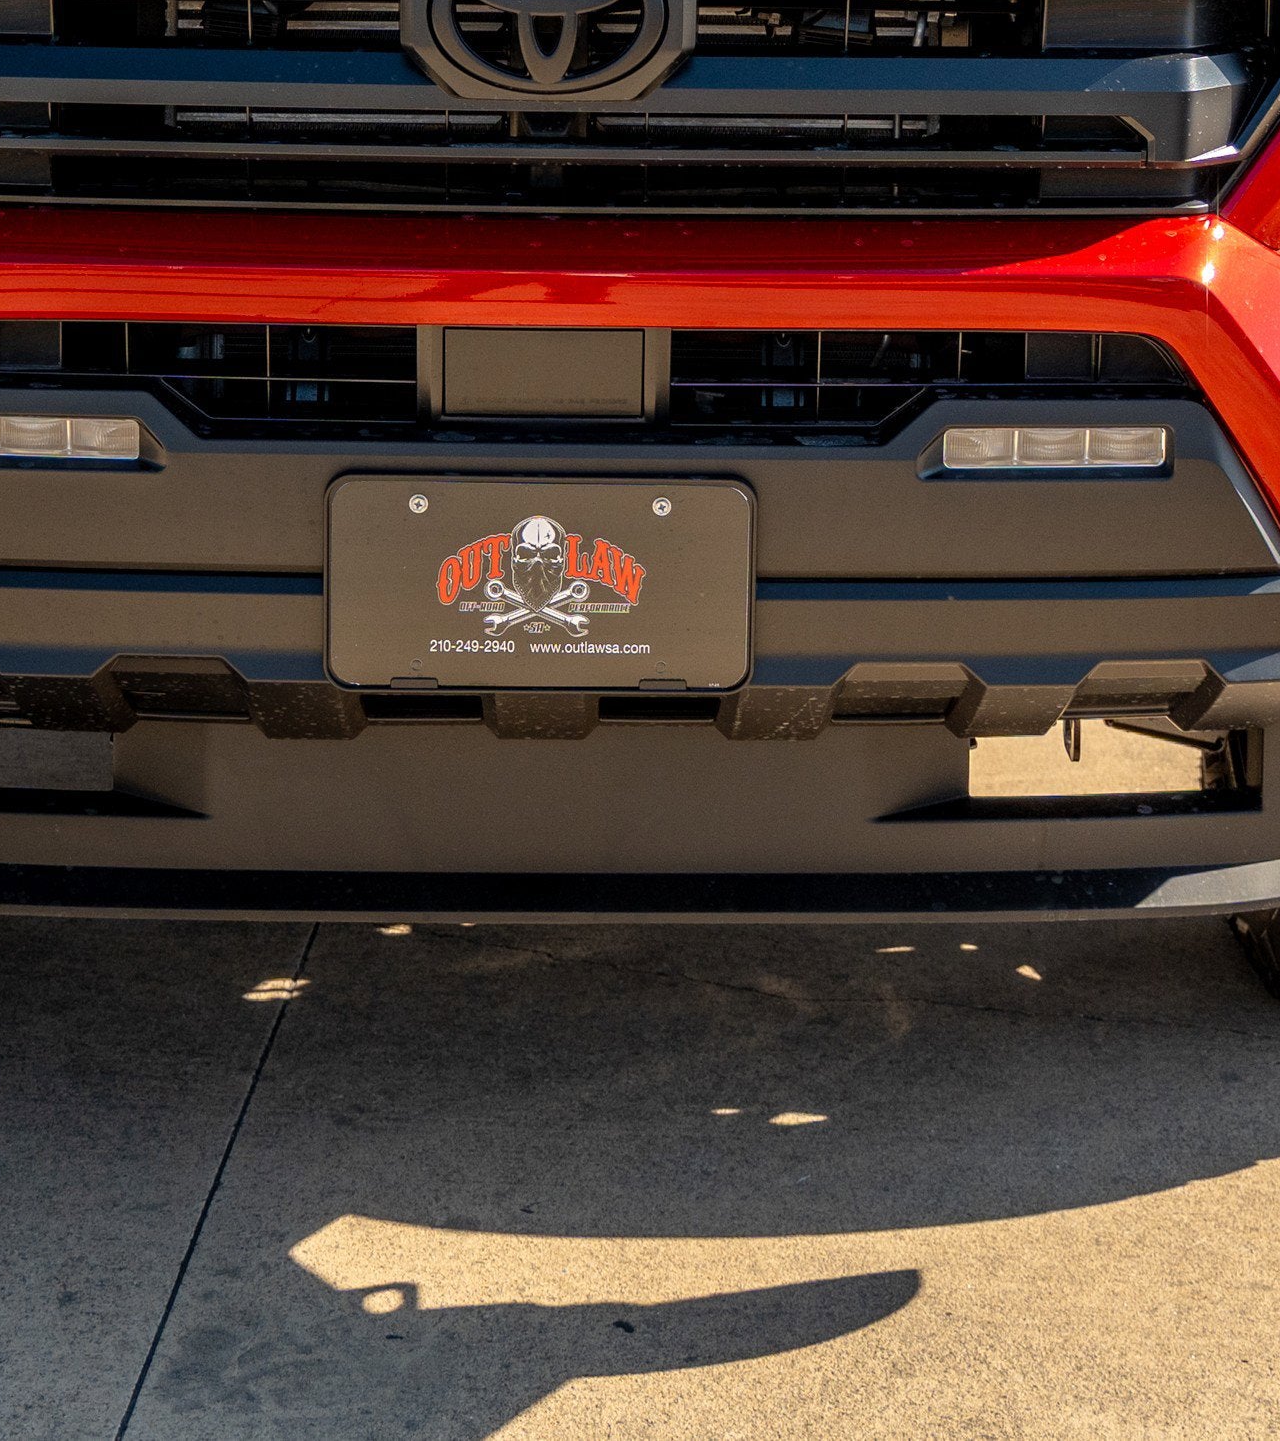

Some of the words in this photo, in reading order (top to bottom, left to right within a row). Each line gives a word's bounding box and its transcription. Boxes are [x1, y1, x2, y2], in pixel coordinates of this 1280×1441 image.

[459, 602, 506, 612] OFF-ROAD
[568, 603, 631, 614] PERFORMANCE
[429, 639, 515, 653] 210-249-2940
[530, 640, 651, 654] www.outlawsa.com
